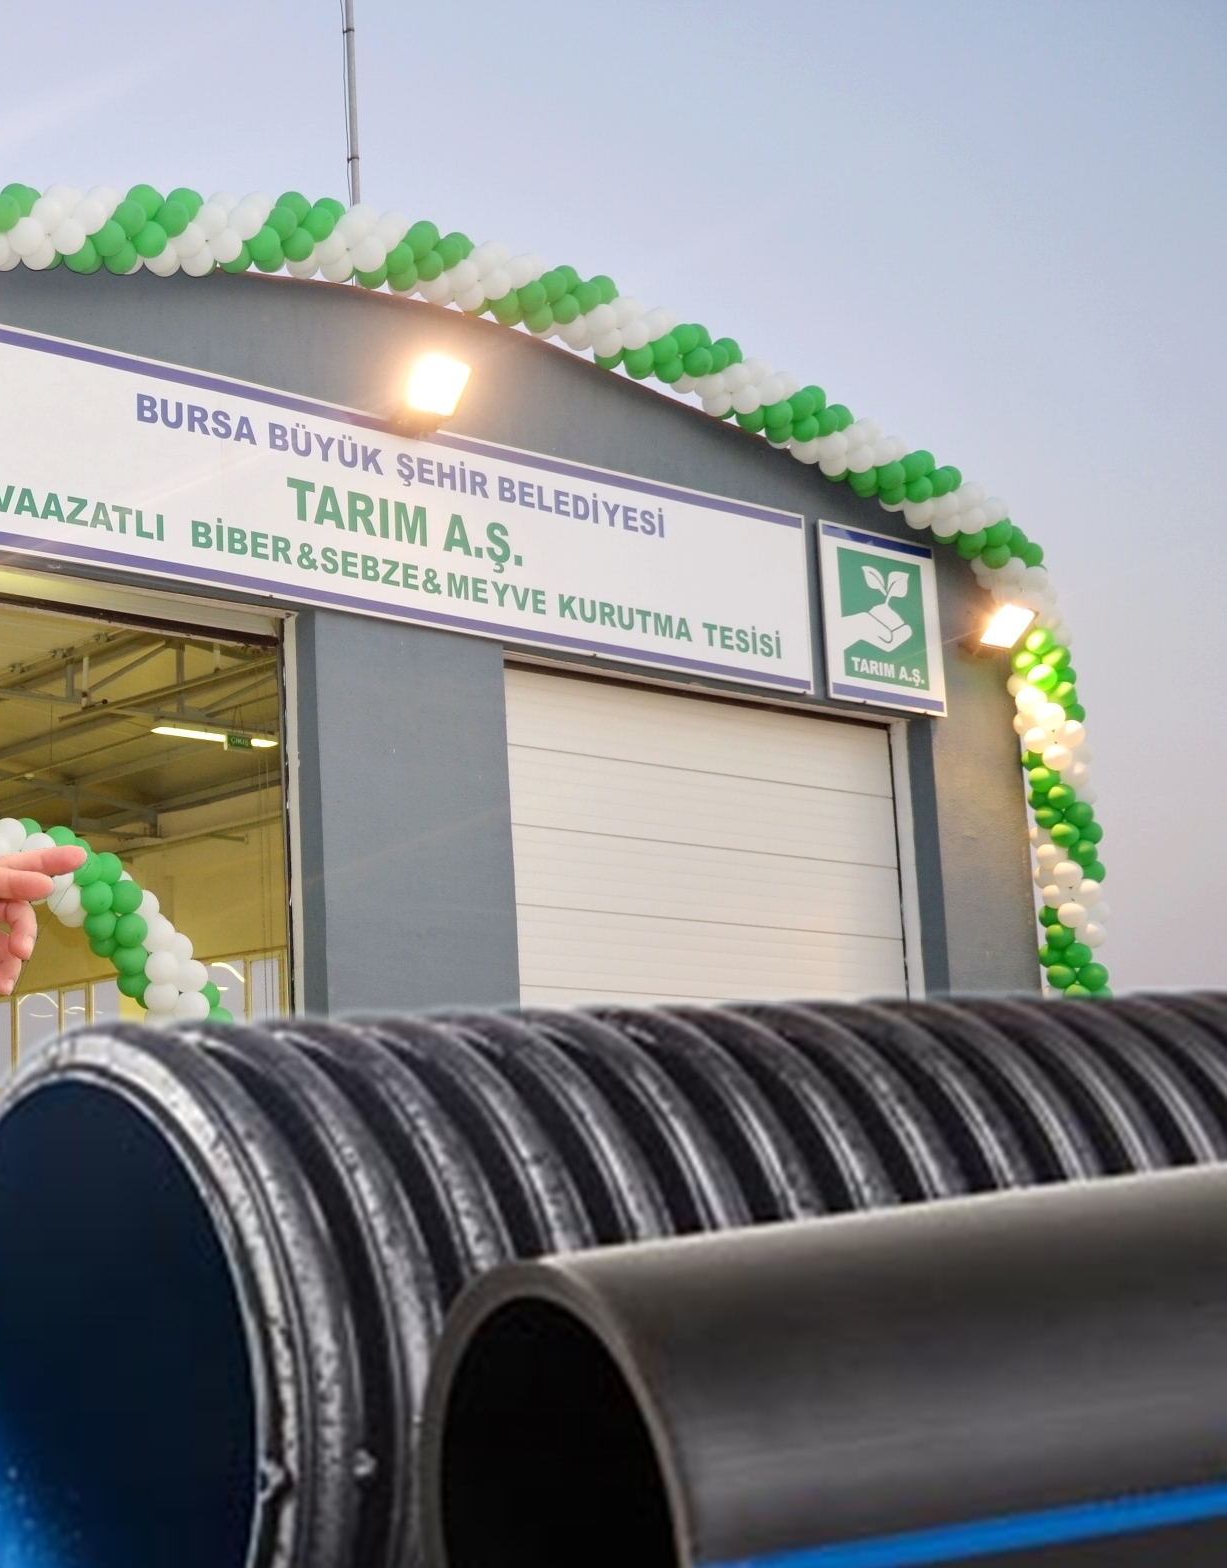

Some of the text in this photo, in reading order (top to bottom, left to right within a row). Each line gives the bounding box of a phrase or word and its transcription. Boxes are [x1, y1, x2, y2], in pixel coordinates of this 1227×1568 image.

[136, 392, 666, 539] BURSA BÜYÜK ŞEHİR BELEDİYESİ
[286, 476, 523, 574] TARIM A.Ş.
[558, 593, 693, 643] KURUTMA
[701, 621, 783, 660] TESİSİ
[851, 656, 926, 687] TARIM A.Ş.
